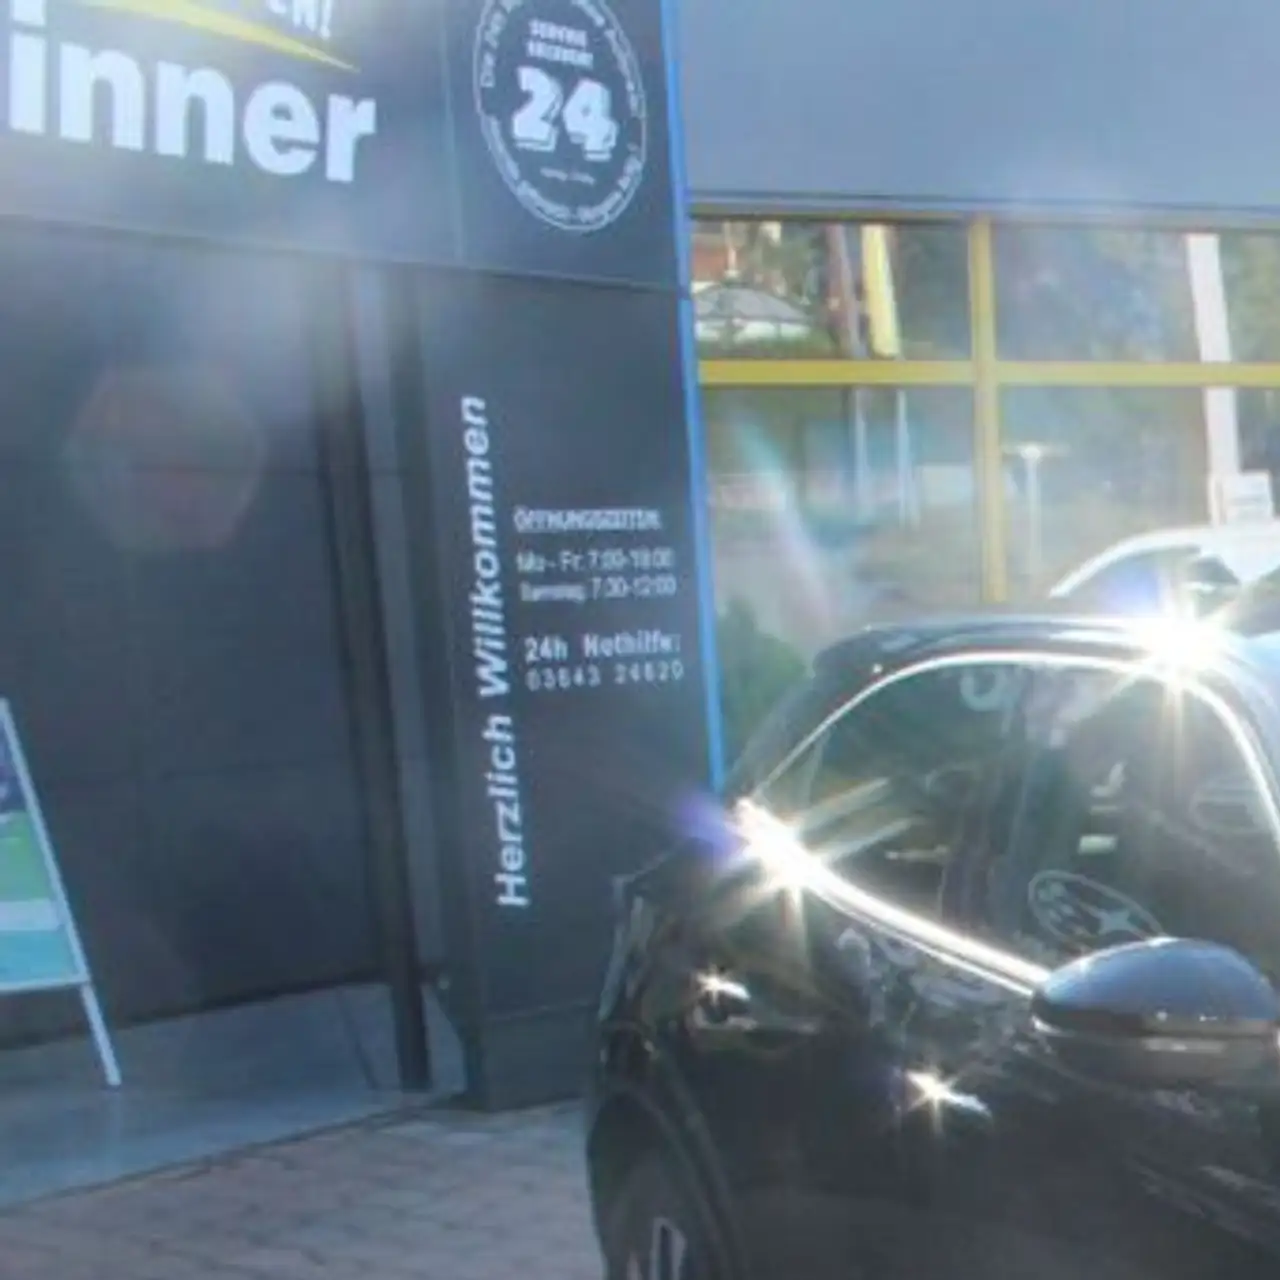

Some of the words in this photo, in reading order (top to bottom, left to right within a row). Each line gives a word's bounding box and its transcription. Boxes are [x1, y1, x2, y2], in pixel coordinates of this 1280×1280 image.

[511, 64, 620, 162] 24
[461, 396, 509, 699] Willkommen
[524, 635, 569, 664] 24h
[482, 713, 529, 907] Herzlich
